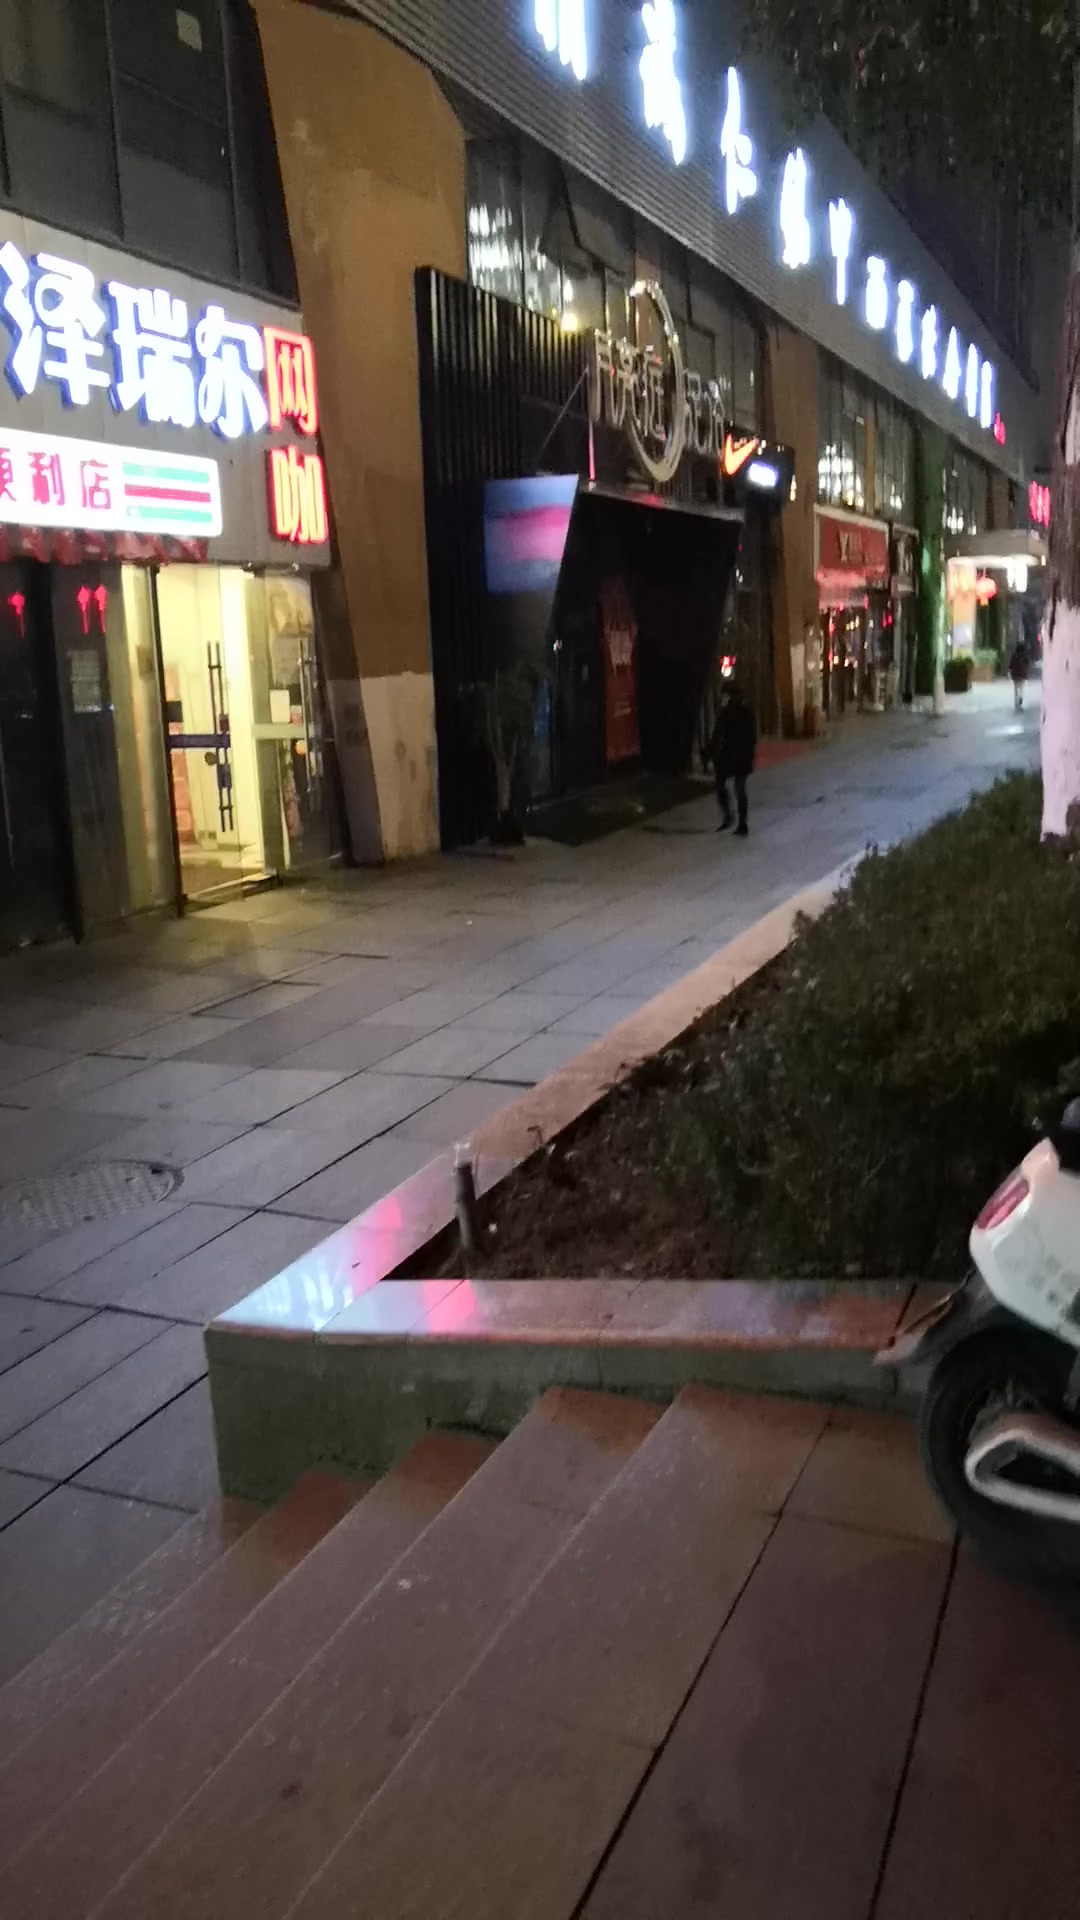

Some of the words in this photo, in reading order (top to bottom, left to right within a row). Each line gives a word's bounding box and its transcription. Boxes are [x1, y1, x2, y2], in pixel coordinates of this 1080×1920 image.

[0, 241, 269, 438] 泽瑞尔
[264, 325, 328, 544] 网咖
